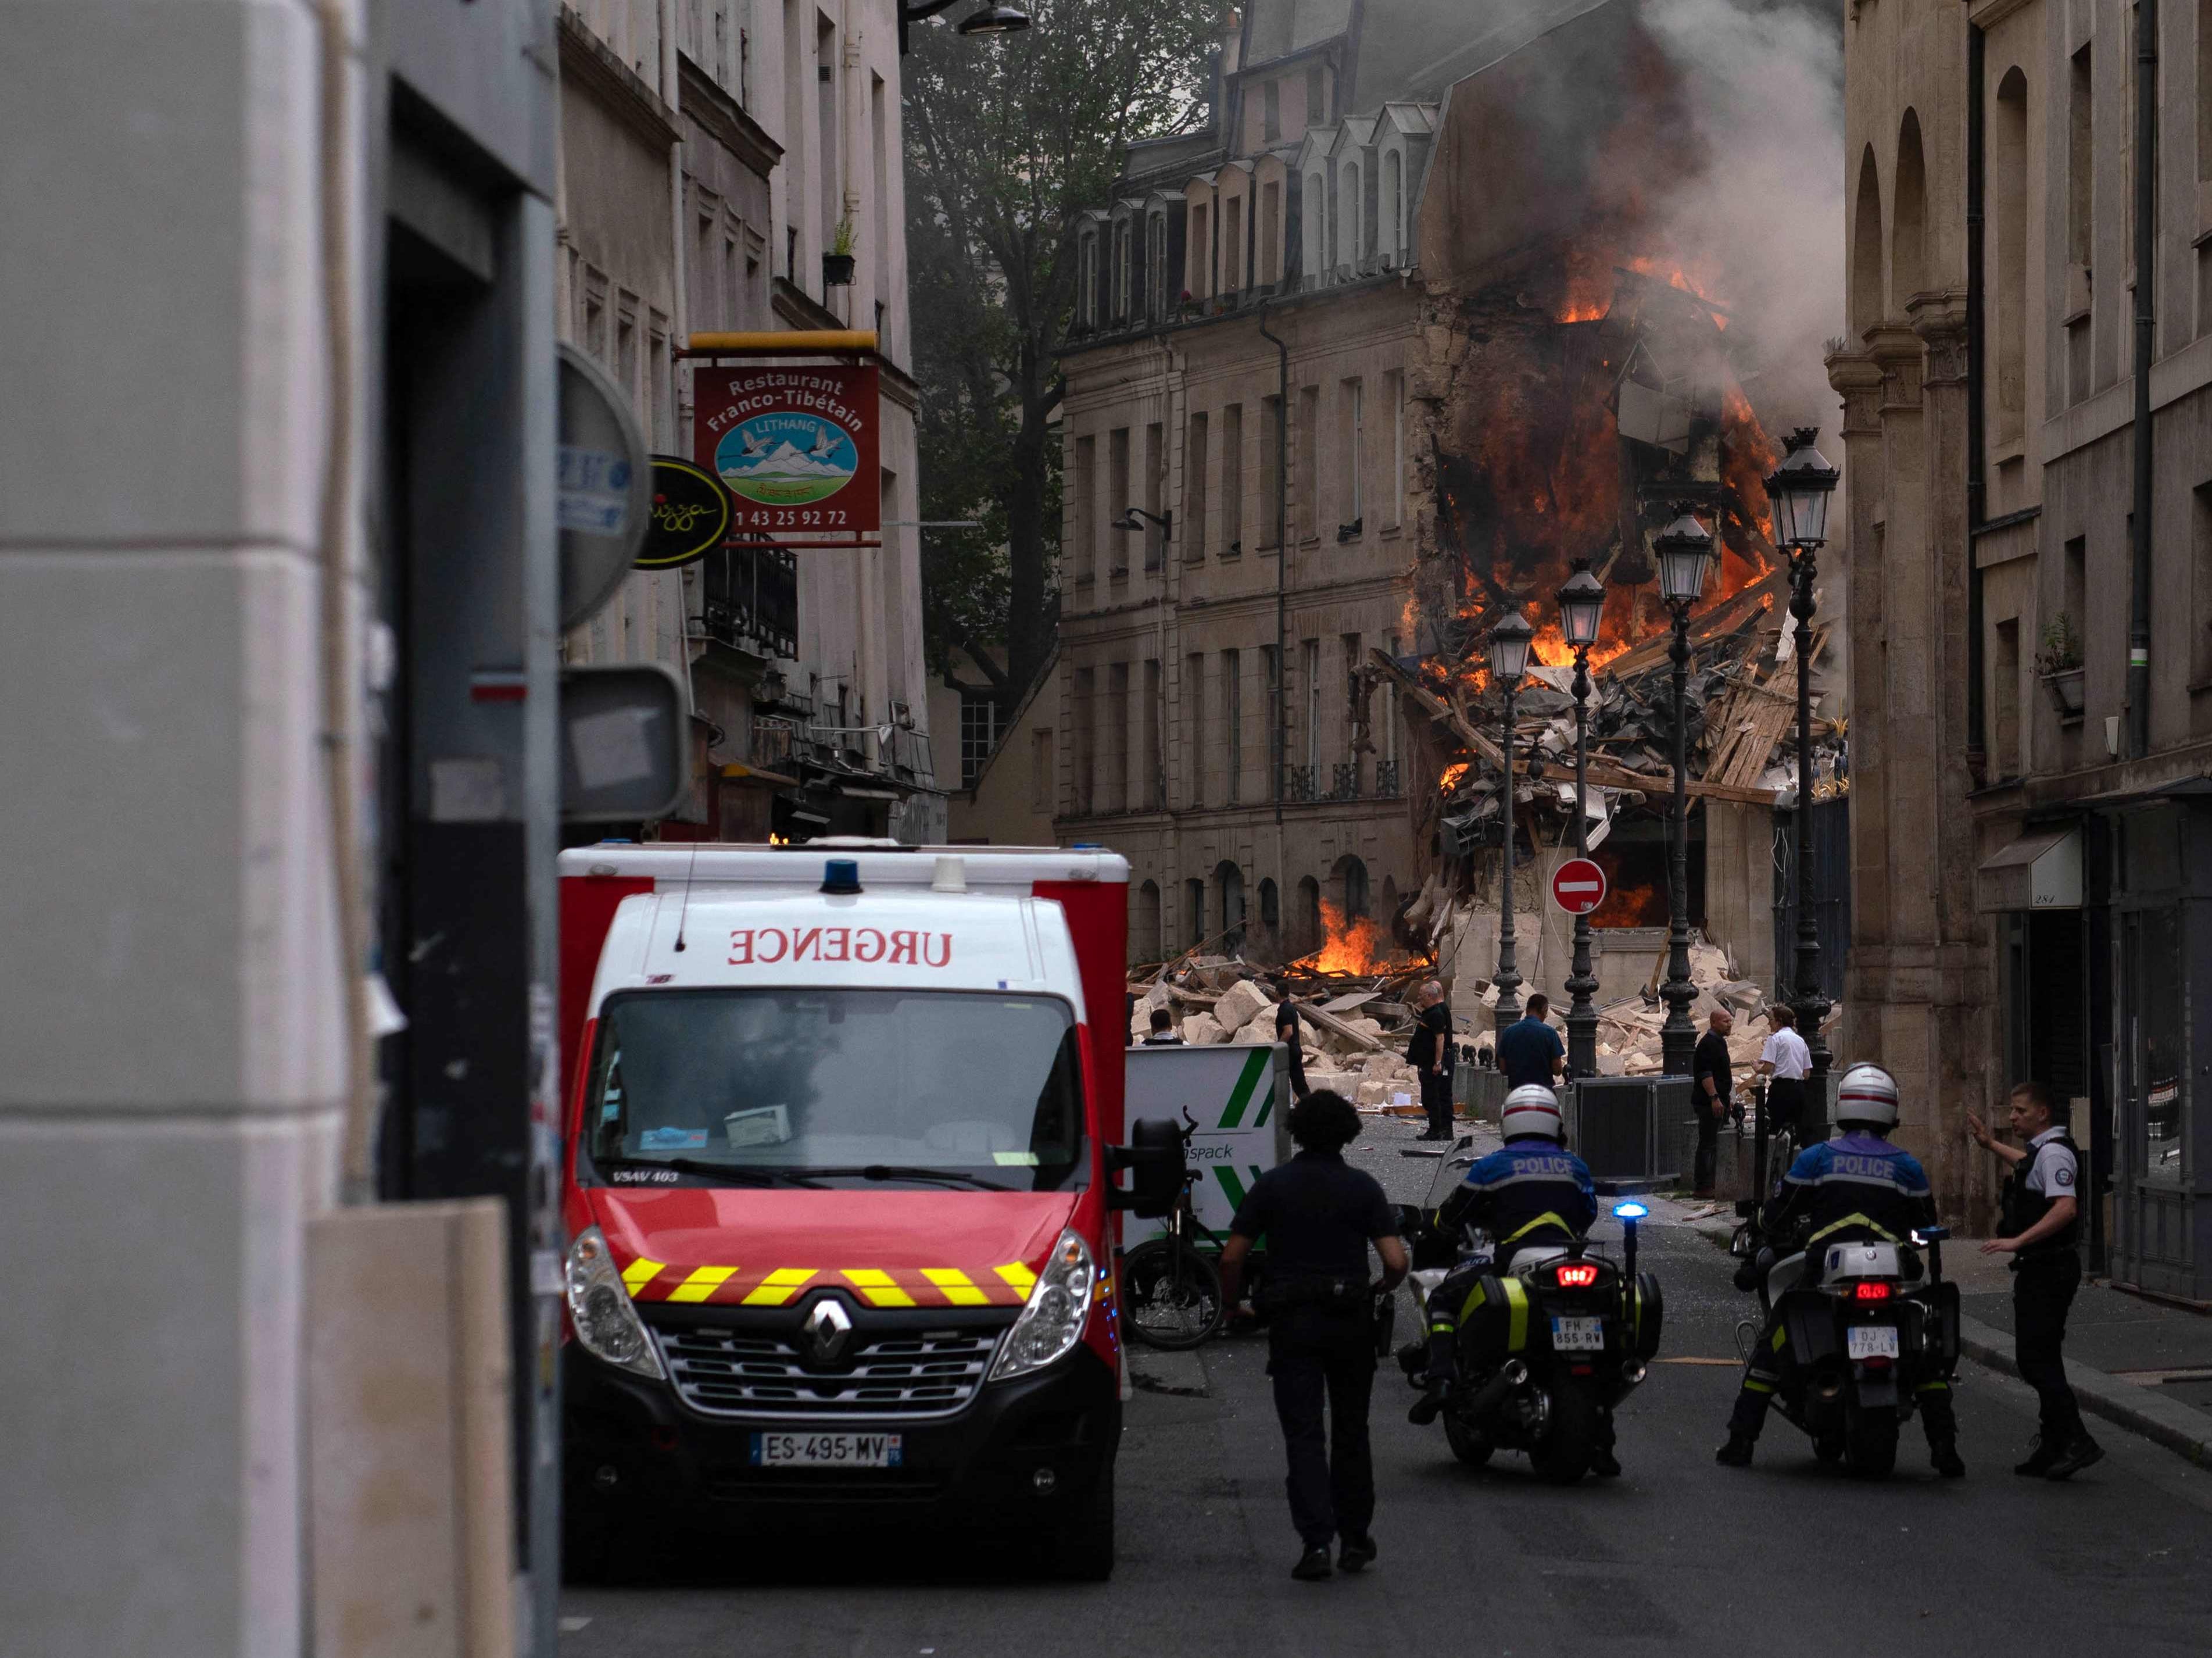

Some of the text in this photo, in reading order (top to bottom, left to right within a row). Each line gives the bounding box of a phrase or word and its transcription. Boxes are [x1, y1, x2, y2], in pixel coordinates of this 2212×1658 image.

[729, 373, 843, 396] Restaurant
[707, 390, 862, 431] Franco-Tibétain
[756, 419, 817, 433] LITHANG
[650, 494, 717, 531] izza
[750, 512, 769, 526] 43
[776, 511, 795, 526] 25
[802, 511, 821, 524] 92
[828, 510, 846, 524] 72
[613, 1171, 679, 1182] VSAV 403
[1513, 1156, 1573, 1175] POLICE
[1833, 1155, 1895, 1179] POLICE
[767, 1436, 884, 1460] ES-495-MV
